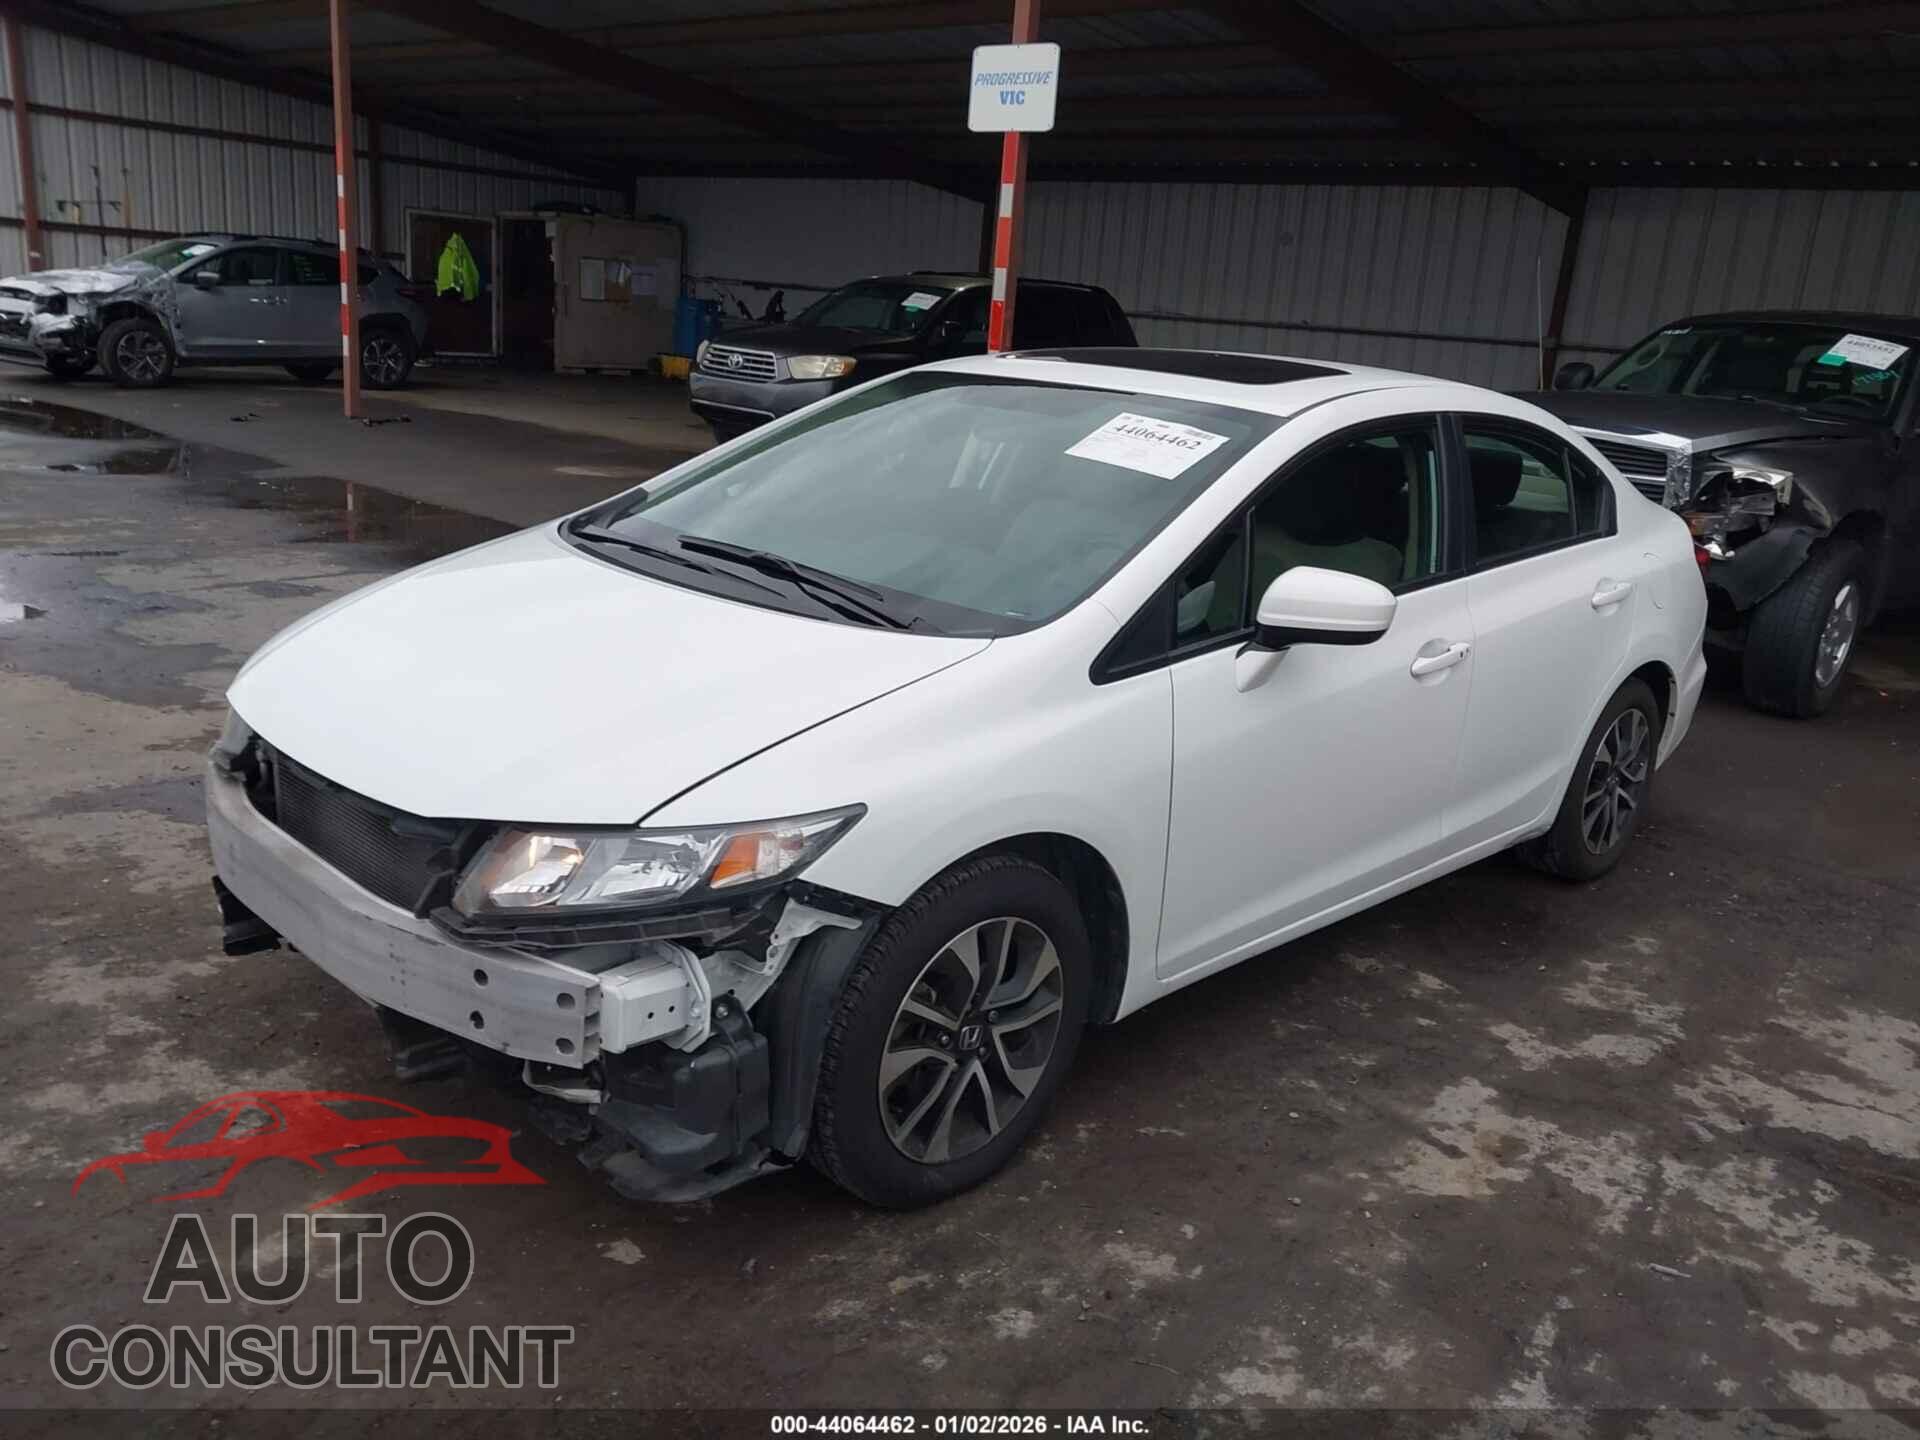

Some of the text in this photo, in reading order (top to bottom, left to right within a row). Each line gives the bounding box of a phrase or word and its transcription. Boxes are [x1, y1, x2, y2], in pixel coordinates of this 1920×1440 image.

[975, 71, 1053, 87] PROGRESSIVE
[1000, 91, 1025, 105] VIC
[1115, 424, 1201, 450] 44064462
